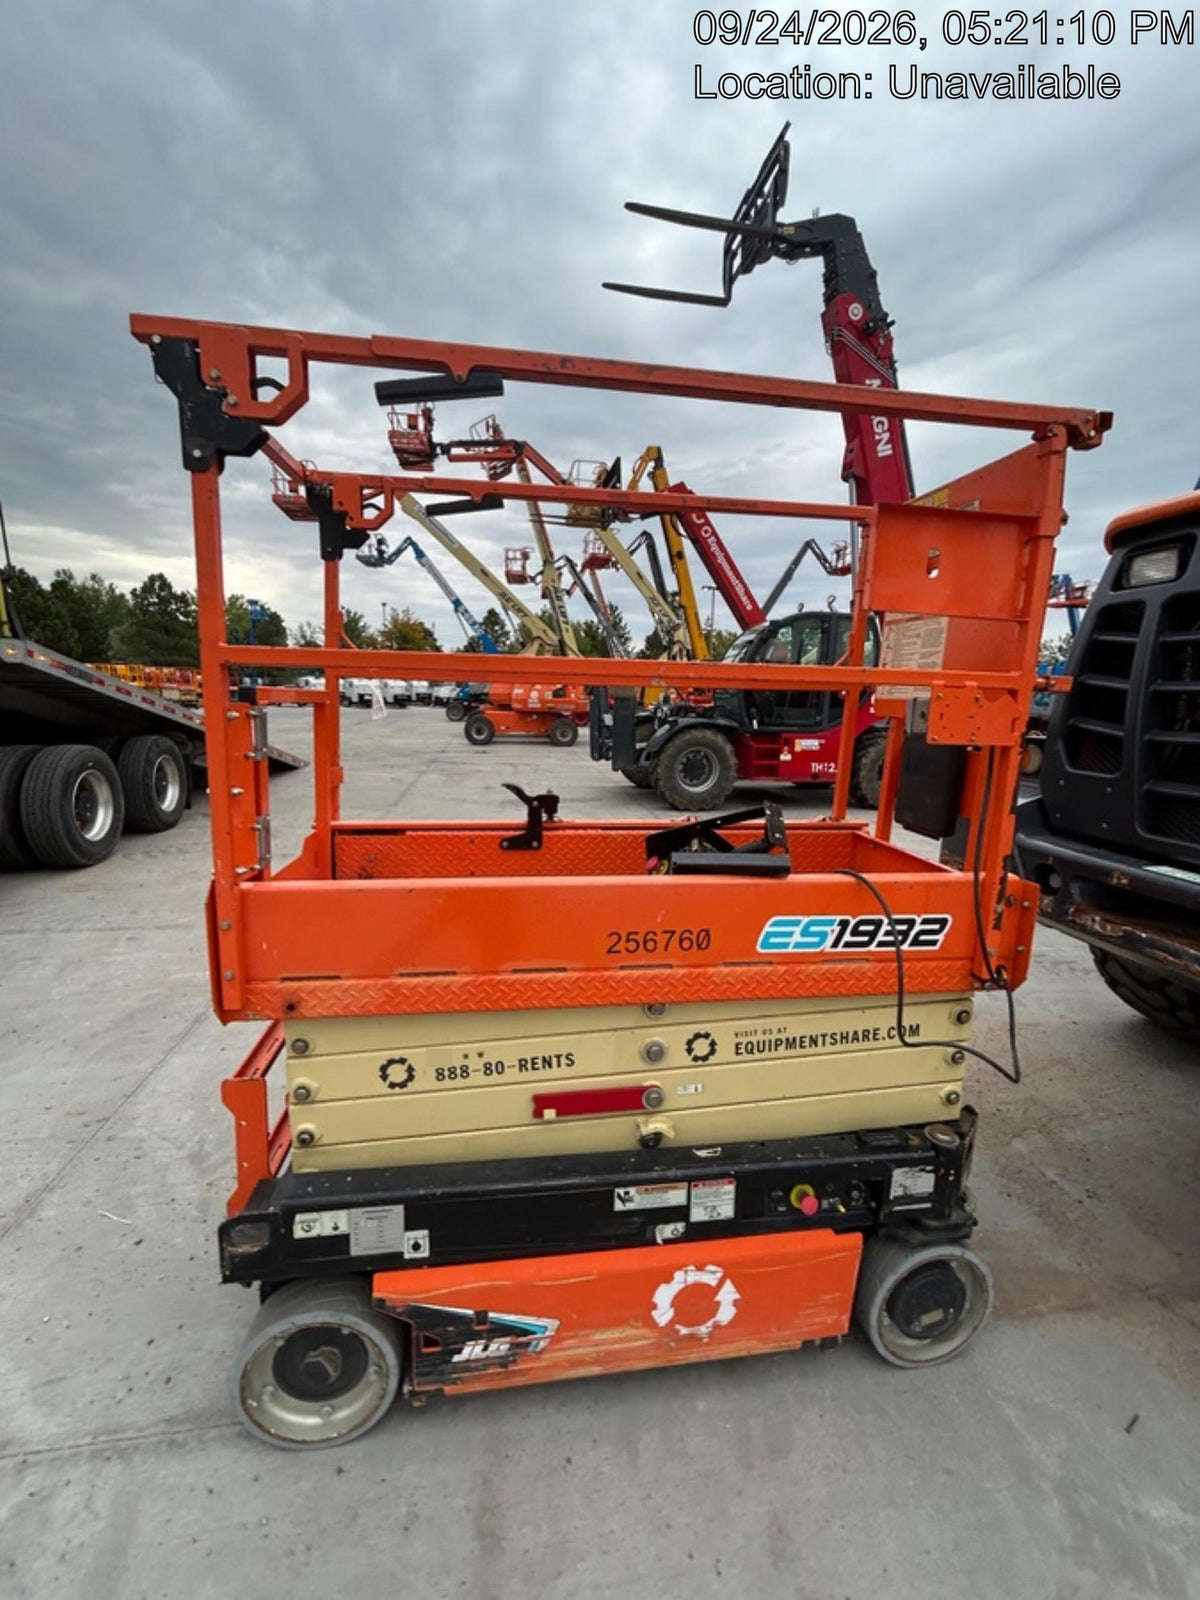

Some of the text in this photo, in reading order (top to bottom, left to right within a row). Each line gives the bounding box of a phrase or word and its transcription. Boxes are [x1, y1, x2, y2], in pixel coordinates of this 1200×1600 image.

[865, 378, 893, 457] GNI
[606, 928, 711, 954] 256760
[757, 917, 950, 954] ES1932
[734, 1026, 788, 1038] VISIT US AT
[735, 1023, 920, 1056] EQUIPMENTSHARE.COM
